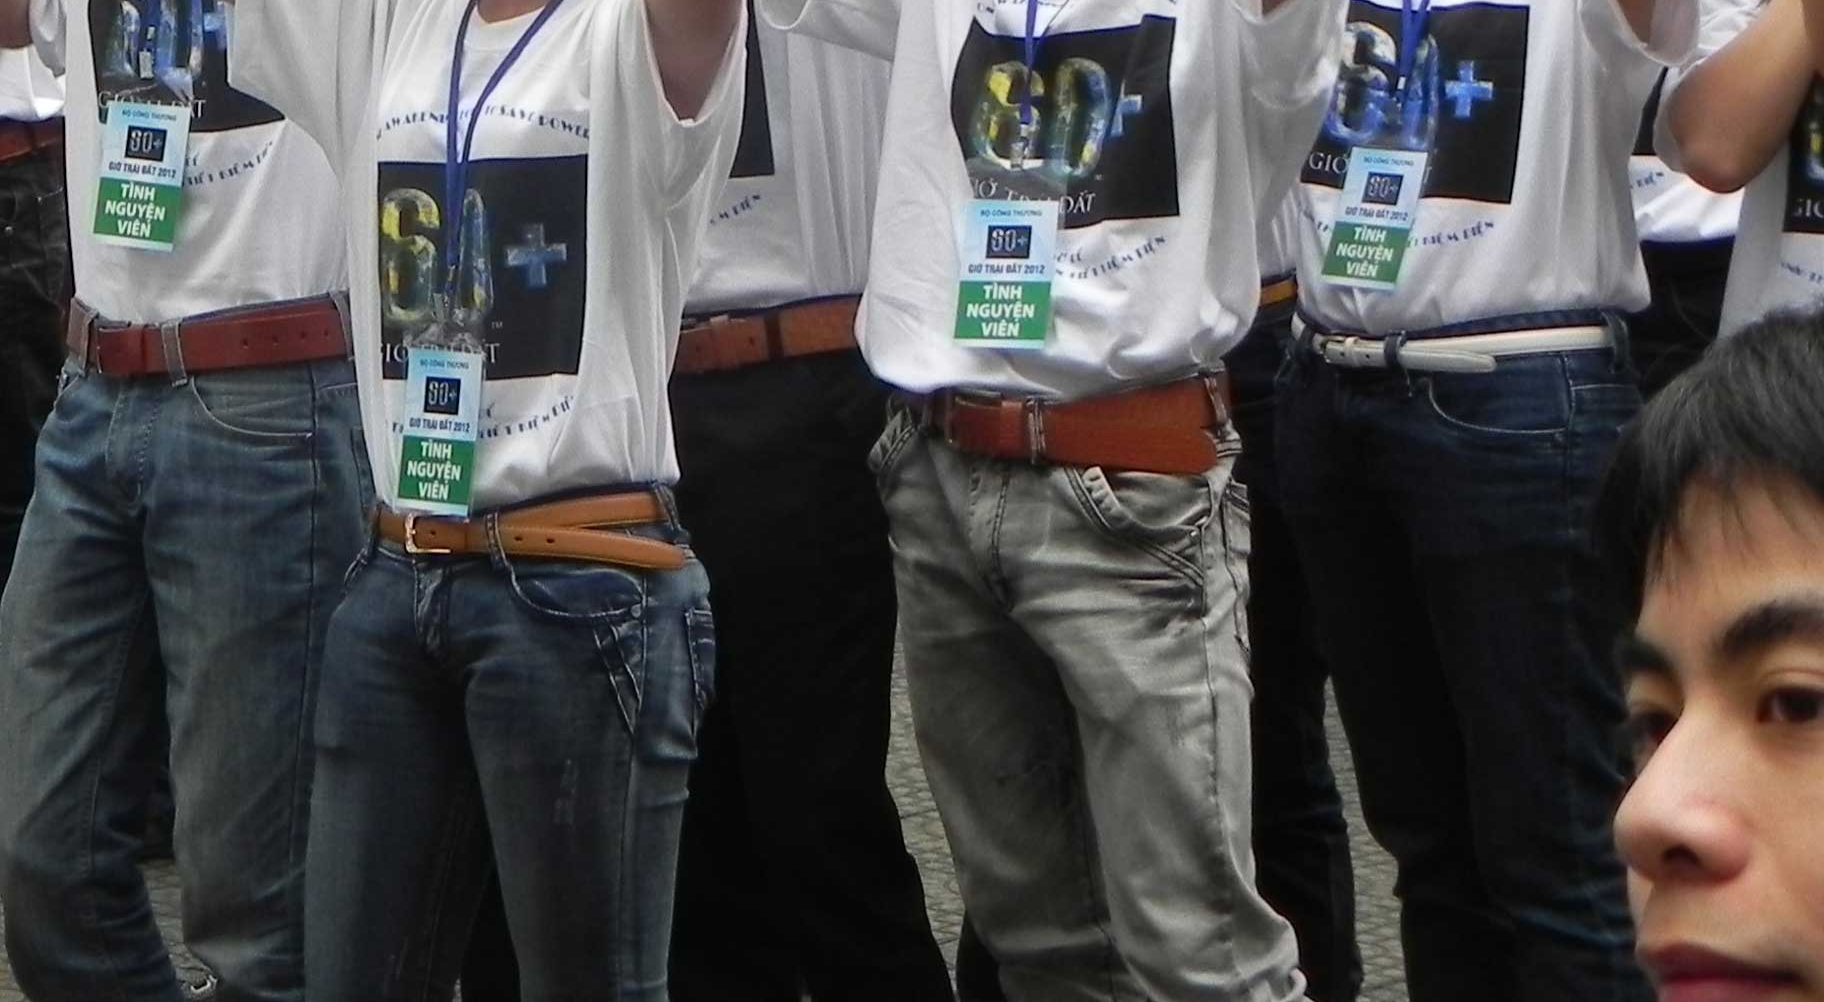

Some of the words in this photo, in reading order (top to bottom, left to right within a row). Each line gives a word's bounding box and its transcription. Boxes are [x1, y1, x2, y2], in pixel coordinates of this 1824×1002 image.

[157, 166, 176, 178] 2012
[120, 182, 155, 201] TÌNH
[105, 200, 165, 222] NGUYỆN
[1390, 210, 1409, 221] 2012
[117, 219, 151, 237] VIÊN
[1354, 224, 1387, 243] TÌNH
[1336, 242, 1394, 263] NGUYỆN
[1024, 264, 1045, 275] 2012
[1346, 260, 1379, 277] VIÊN
[983, 281, 1022, 299] TÌNH
[966, 302, 1035, 321] NGUYỆN
[981, 319, 1020, 338] VIÊN
[454, 422, 470, 433] 2012
[420, 438, 452, 459] TÌNH
[407, 458, 461, 482] NGUYỆN
[418, 480, 449, 501] VIÊN
